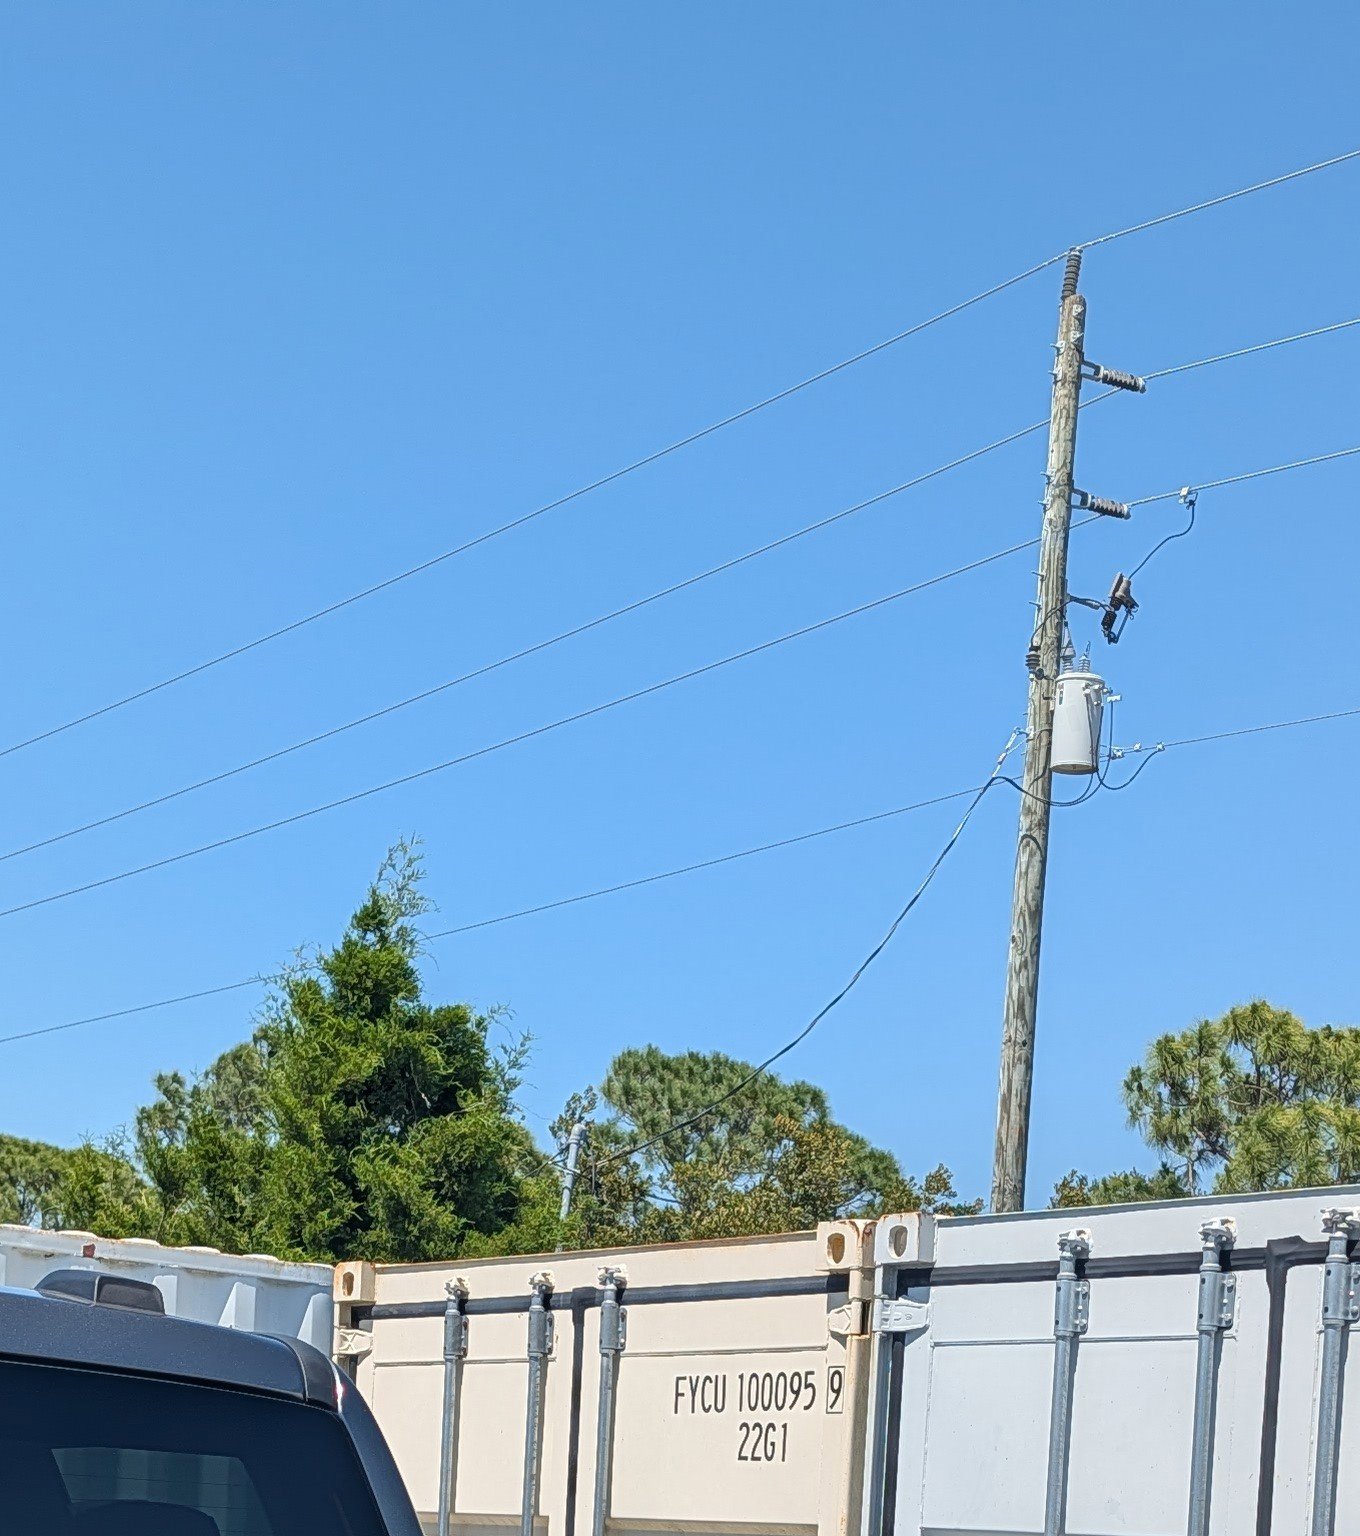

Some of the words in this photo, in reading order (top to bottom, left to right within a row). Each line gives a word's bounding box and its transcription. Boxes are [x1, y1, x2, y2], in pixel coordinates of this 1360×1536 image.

[674, 1374, 727, 1414] FYCU
[738, 1371, 816, 1412] 100095
[828, 1368, 844, 1411] 9
[737, 1422, 788, 1462] 22G1
